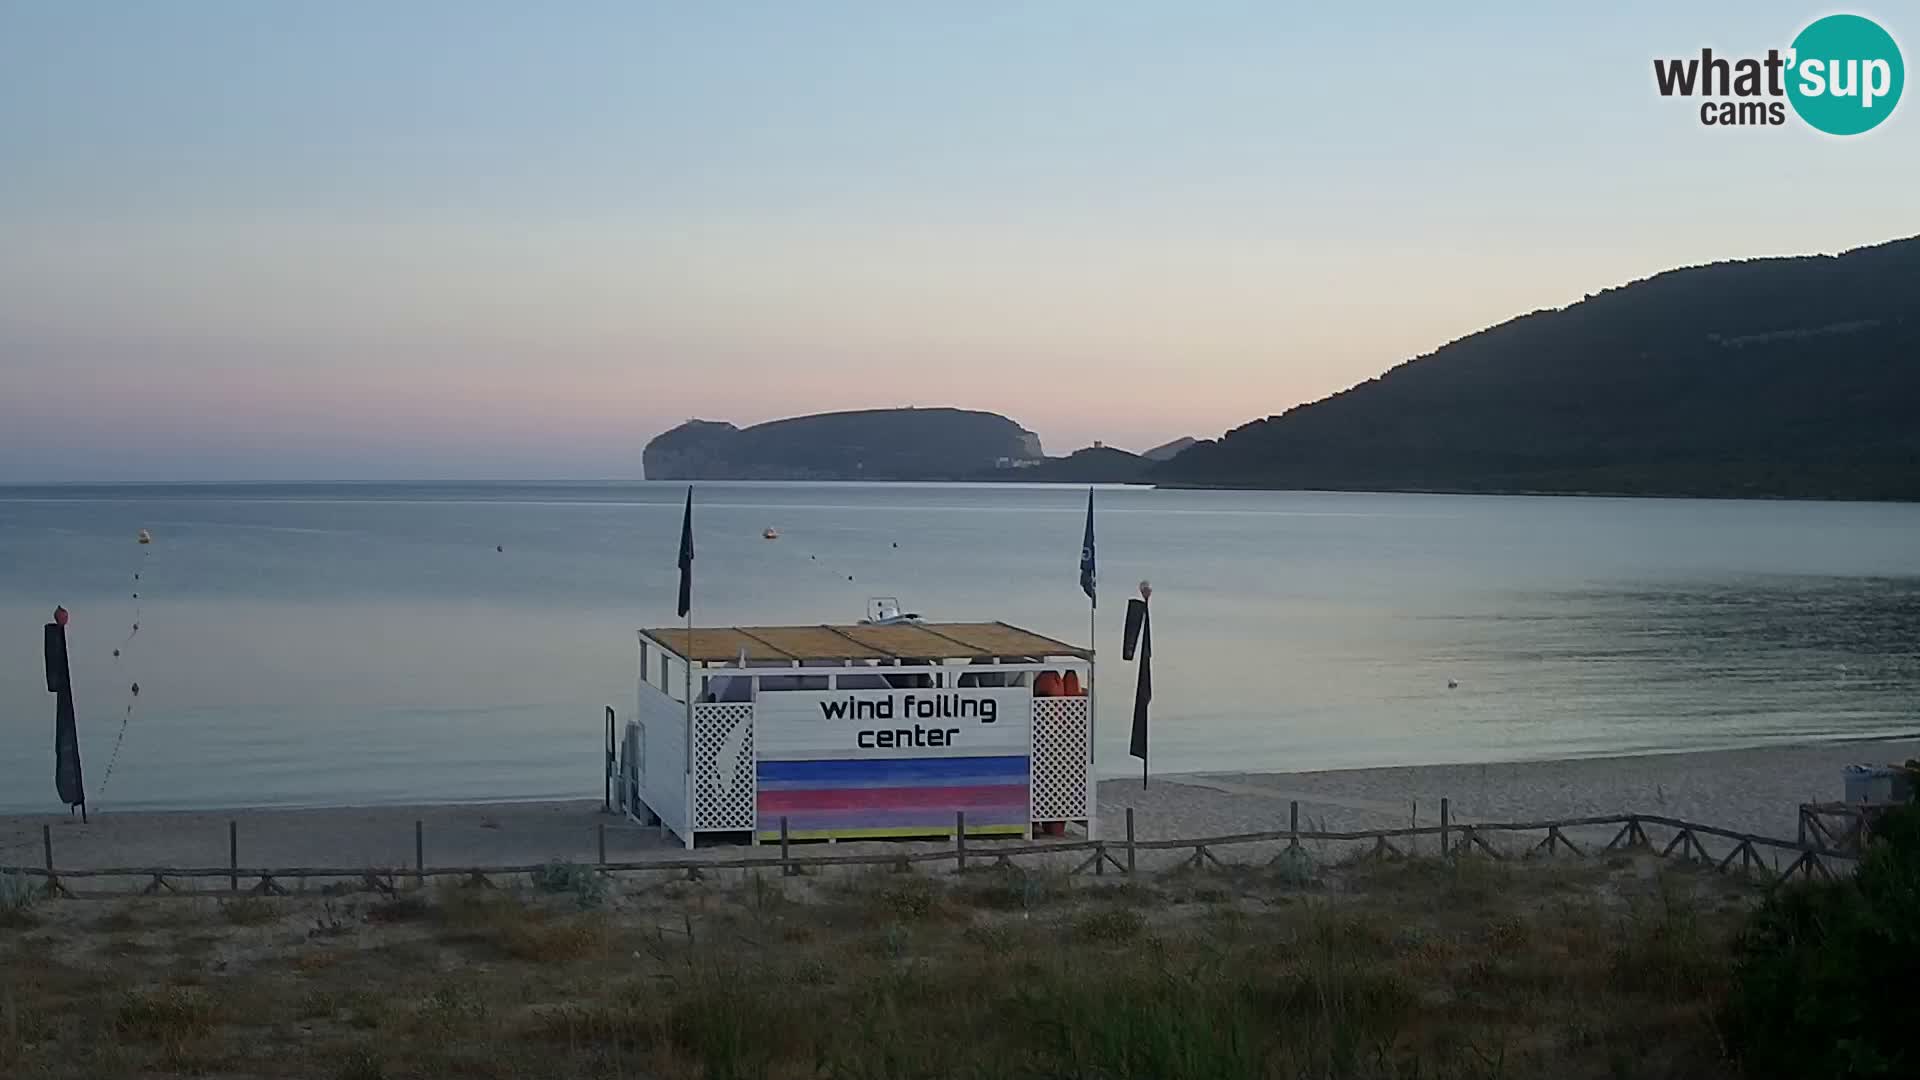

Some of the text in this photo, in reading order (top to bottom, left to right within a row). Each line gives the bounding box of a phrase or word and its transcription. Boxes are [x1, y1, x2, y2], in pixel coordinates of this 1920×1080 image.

[820, 694, 998, 723] wind foiling
[857, 725, 960, 748] center
